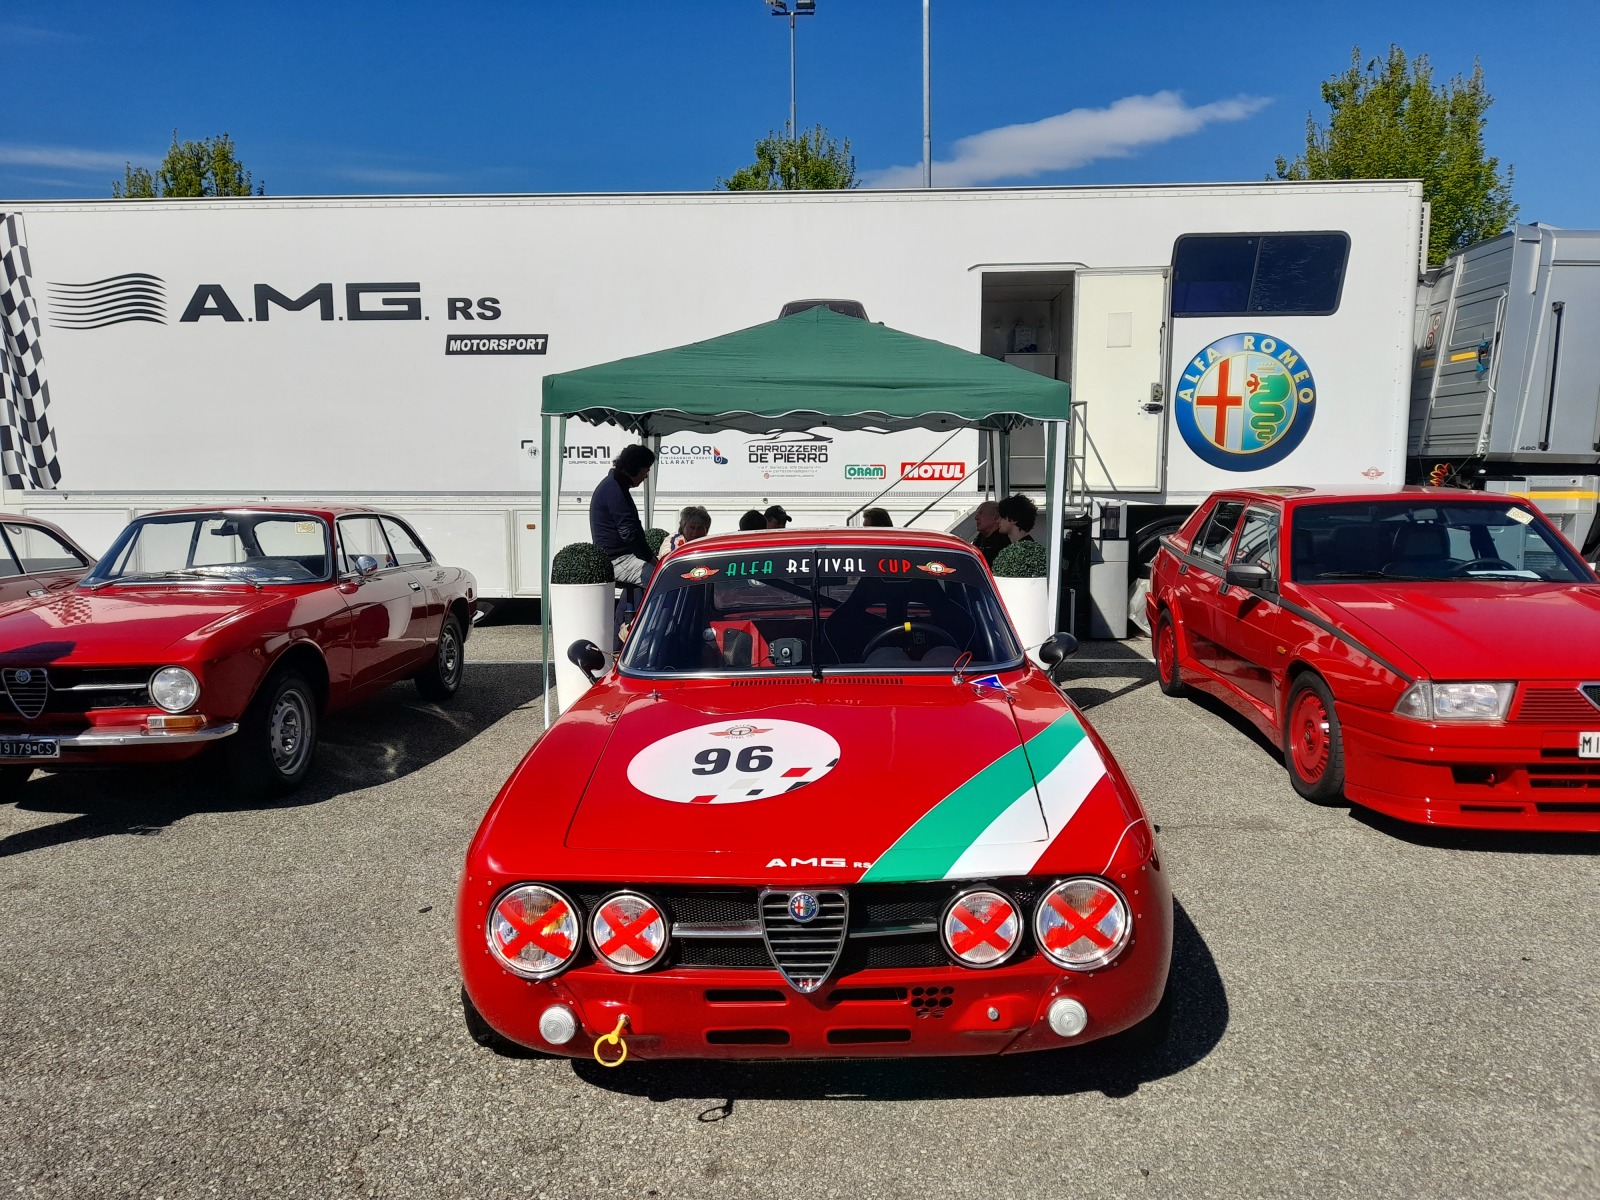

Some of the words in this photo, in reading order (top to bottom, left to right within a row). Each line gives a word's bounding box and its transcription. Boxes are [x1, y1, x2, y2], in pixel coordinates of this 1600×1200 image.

[179, 282, 429, 322] A.M.G.
[447, 297, 502, 320] RS
[450, 338, 546, 352] MOTORSPORT
[1178, 347, 1223, 403] ALFA
[1243, 335, 1314, 404] ROMEO
[659, 445, 712, 455] COLOR
[748, 445, 828, 453] CARROZZERIA
[748, 453, 769, 463] DE
[773, 453, 829, 463] PIERRO
[847, 467, 884, 477] ORAM
[902, 464, 964, 478] MOTUL
[725, 560, 773, 577] ALFA
[877, 558, 912, 574] CUP
[691, 745, 774, 776] 96
[853, 861, 872, 869] RS
